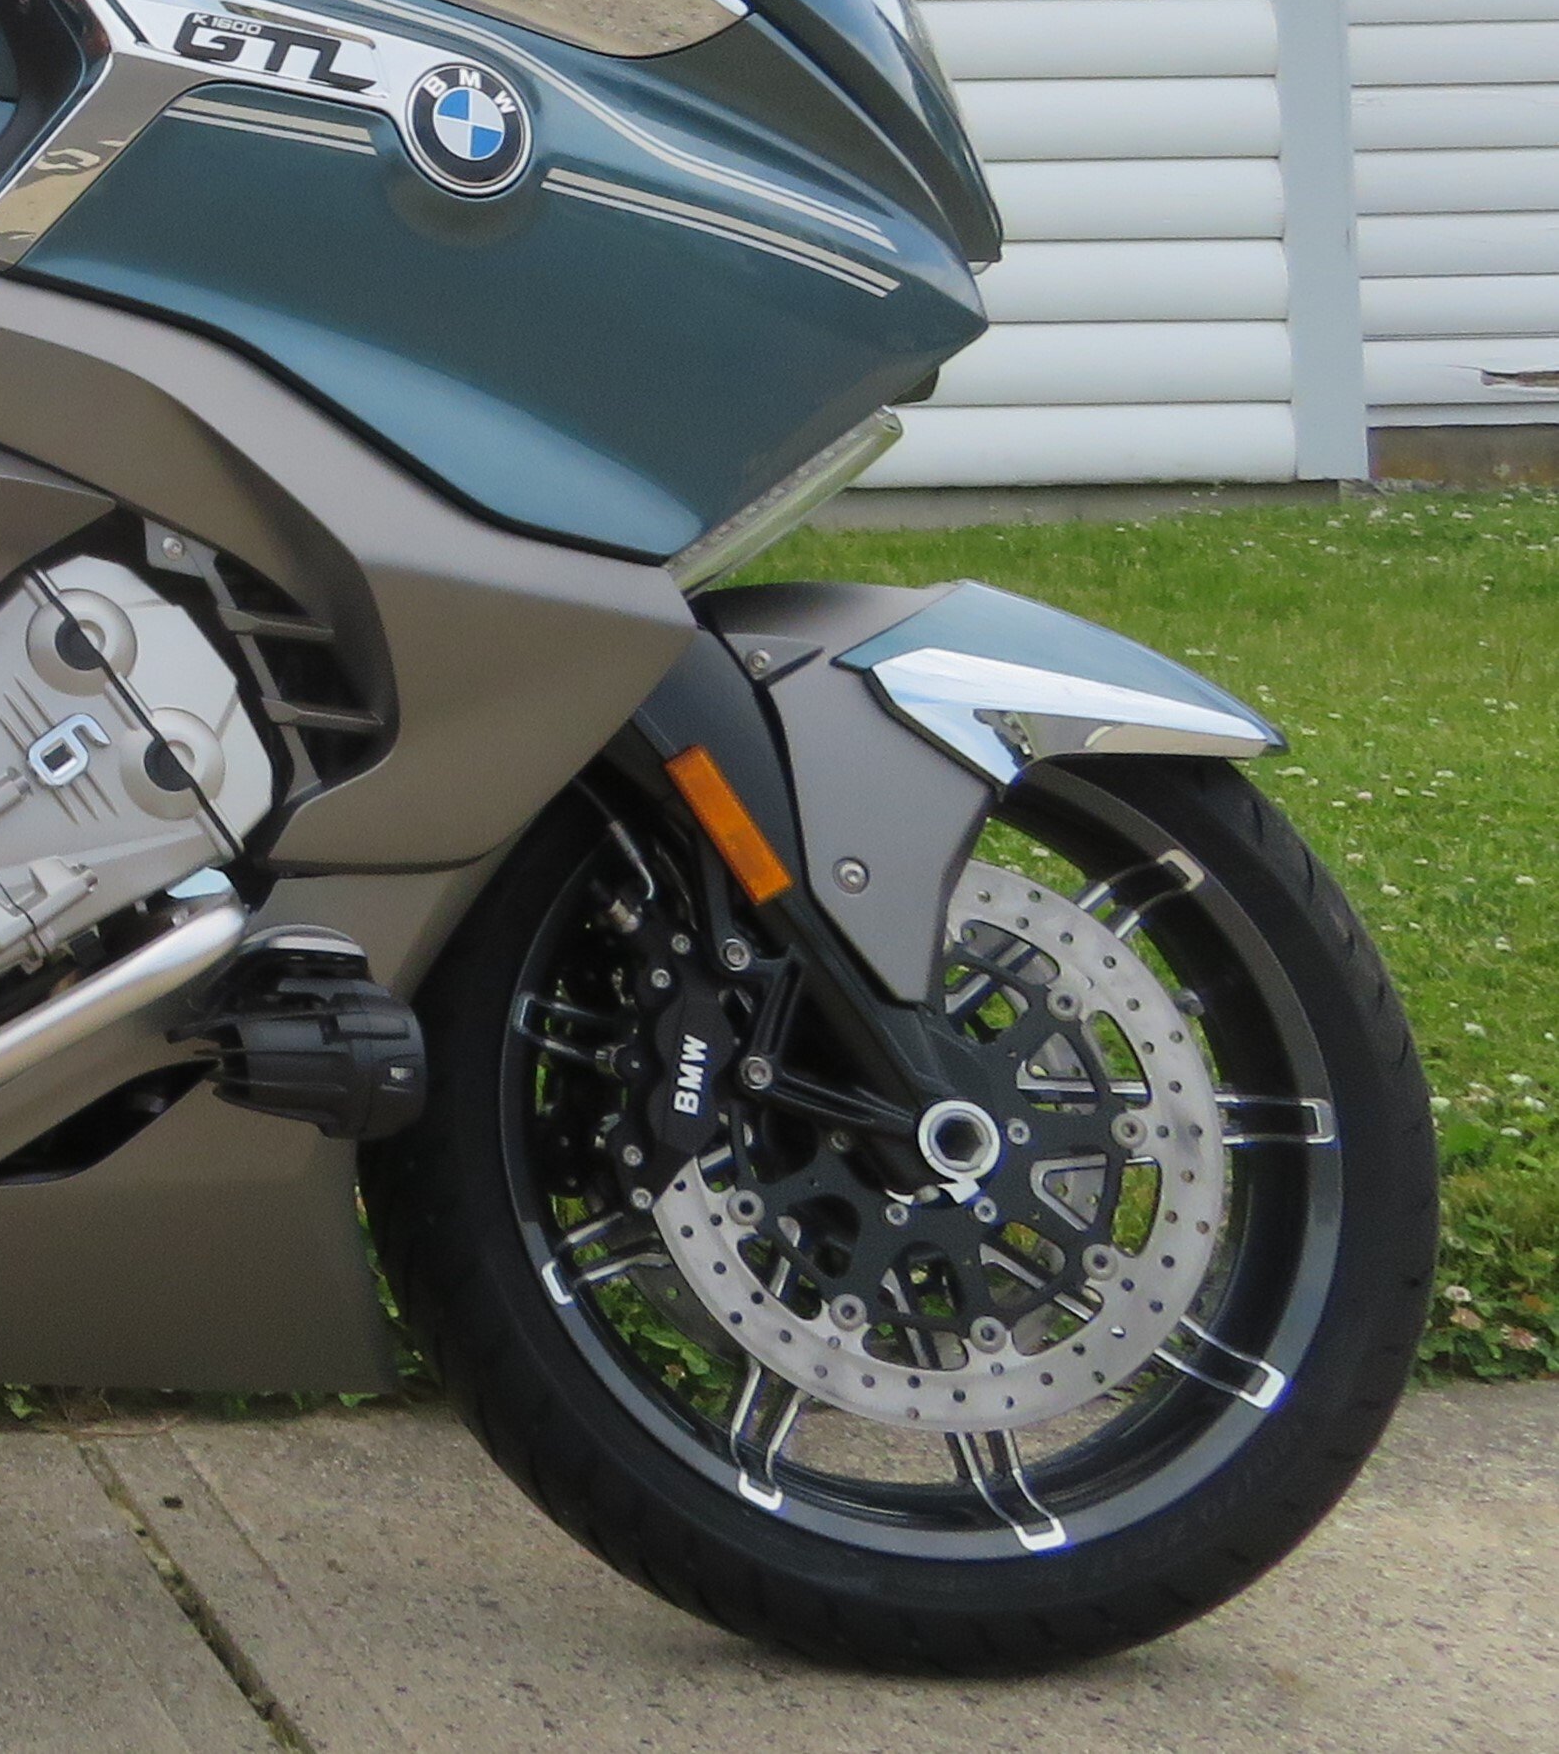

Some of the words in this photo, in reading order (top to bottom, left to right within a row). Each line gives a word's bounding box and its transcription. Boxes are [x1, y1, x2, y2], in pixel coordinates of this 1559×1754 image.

[173, 12, 377, 91] GTL
[191, 13, 209, 27] K
[210, 17, 262, 36] 1600
[422, 67, 516, 115] BMW
[671, 1032, 709, 1116] BMW
